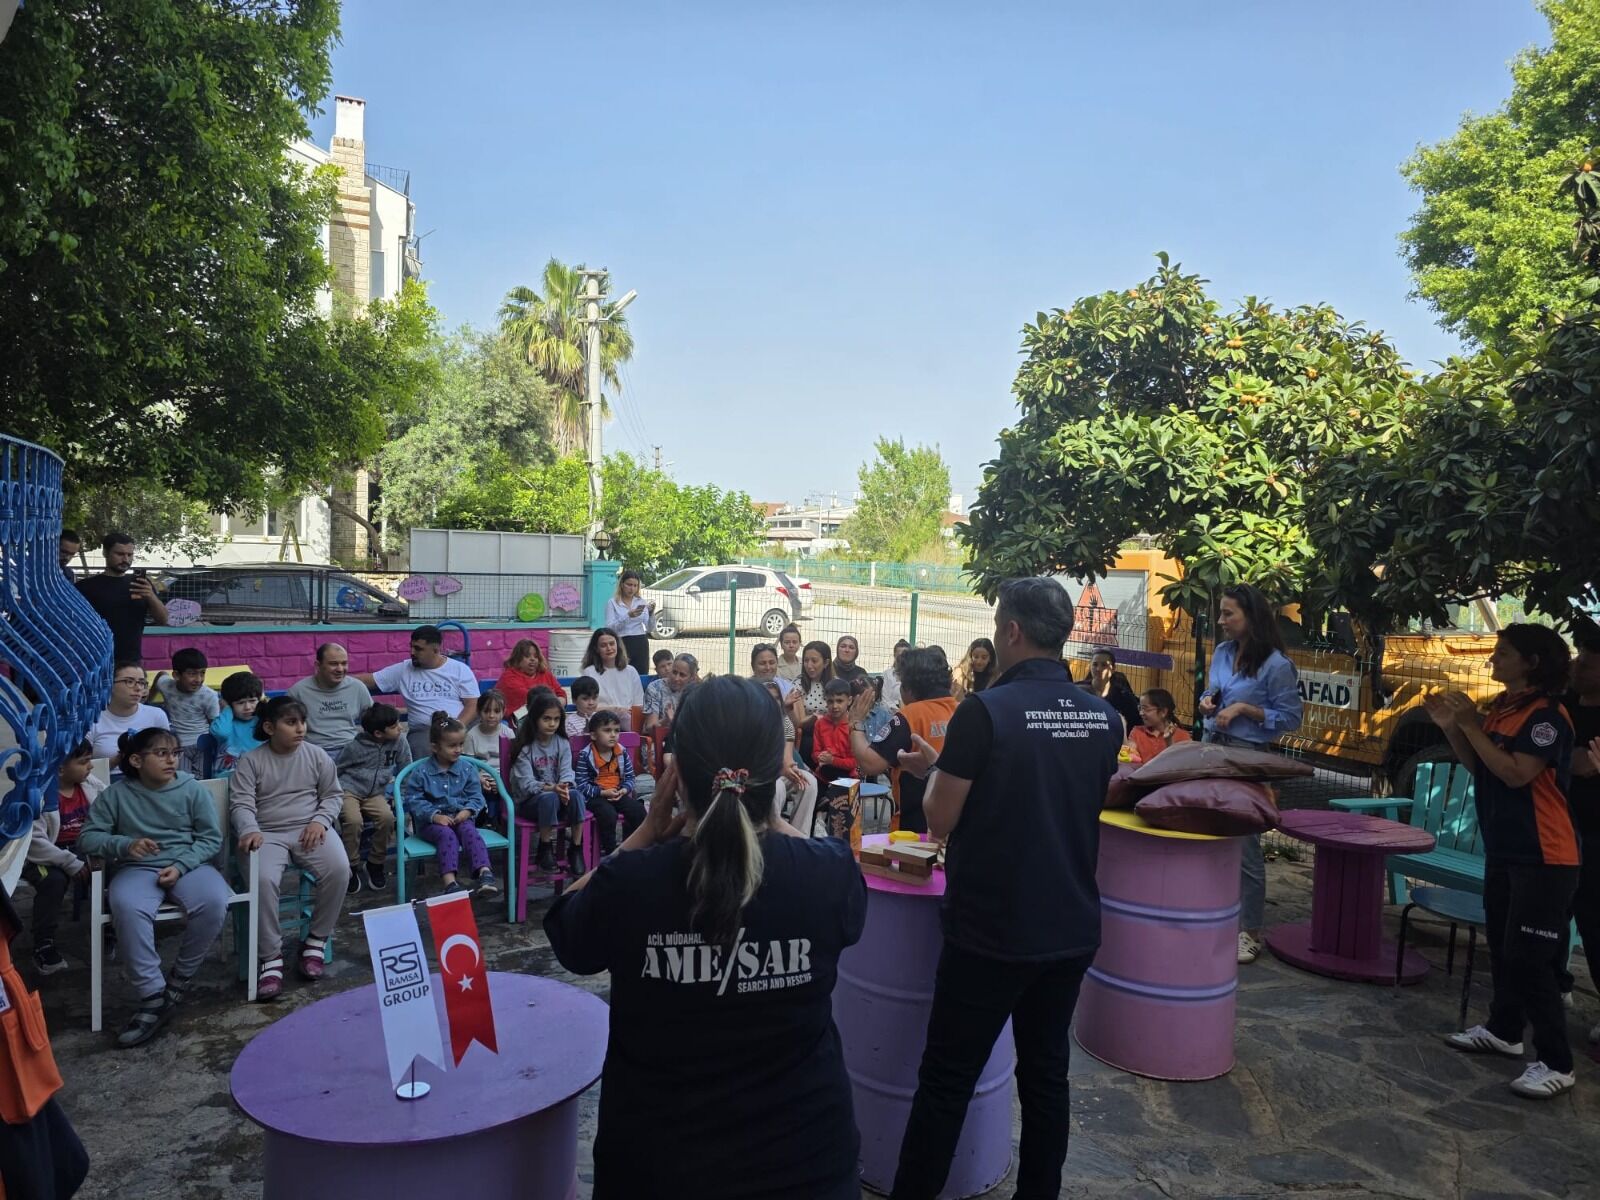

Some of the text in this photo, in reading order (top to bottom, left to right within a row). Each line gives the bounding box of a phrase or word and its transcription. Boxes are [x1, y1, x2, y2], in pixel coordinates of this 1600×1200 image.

[412, 681, 452, 692] BOSS
[1296, 680, 1350, 706] AFAD
[1058, 699, 1075, 707] T.C.
[1025, 709, 1107, 721] FETHİYE BELEDİYESİ
[1026, 722, 1043, 730] AFET
[647, 932, 664, 946] ACİL
[388, 972, 419, 986] RAMSA
[737, 979, 768, 993] SEARCH
[769, 977, 785, 990] AND
[383, 985, 429, 1007] GROUP
